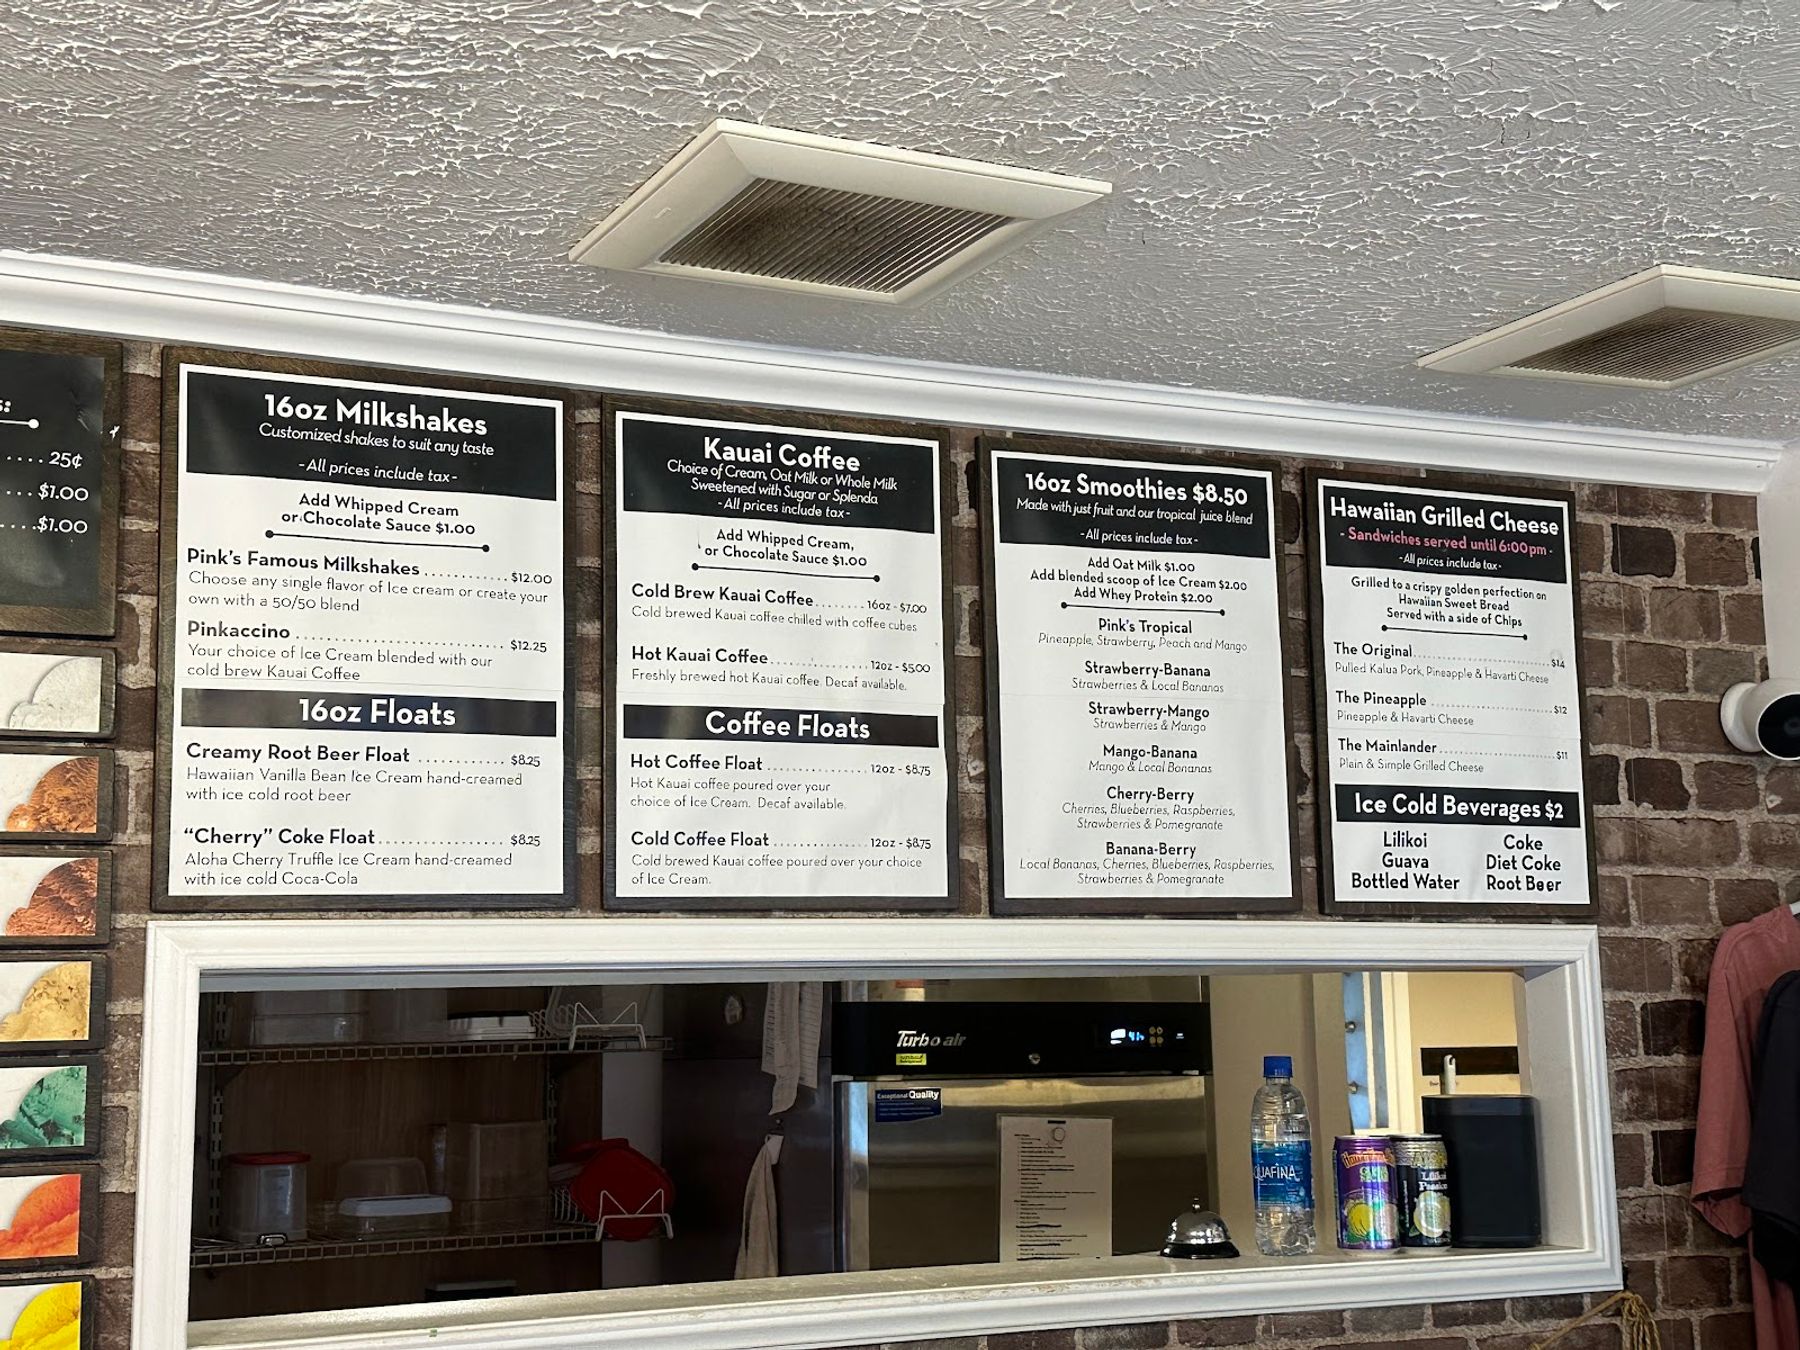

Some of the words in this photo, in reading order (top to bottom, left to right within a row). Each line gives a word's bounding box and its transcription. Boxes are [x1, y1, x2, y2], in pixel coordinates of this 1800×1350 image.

[264, 393, 327, 420] 16oz
[336, 398, 487, 435] Milkshakes
[259, 422, 342, 442] Customized
[343, 429, 388, 447] shakes
[392, 435, 405, 448] to
[408, 437, 431, 450] suit
[434, 442, 459, 455] any
[462, 441, 493, 455] taste
[48, 451, 83, 469] 25¢
[704, 436, 771, 463] Kauai
[778, 443, 860, 471] Coffee
[328, 462, 369, 476] prices
[374, 465, 423, 480] include
[37, 482, 89, 501] $1.00
[1025, 471, 1070, 492] 16oz
[1076, 473, 1187, 500] Smoothies
[1192, 482, 1247, 506] $8.50
[298, 493, 329, 507] Add
[334, 495, 402, 513] Whipped
[408, 501, 458, 516] Cream
[36, 515, 88, 533] $1.00
[281, 512, 298, 523] or
[302, 511, 382, 529] Chocolate
[385, 517, 430, 532] Sauce
[435, 521, 476, 535] $1.00
[1330, 496, 1416, 523] Hawaiian
[1421, 505, 1485, 529] Grilled
[1489, 510, 1558, 535] Cheese
[716, 528, 742, 541] Add
[746, 530, 803, 547] Whipped
[807, 535, 853, 551] Cream,
[1348, 526, 1421, 545] Sandwiches
[1423, 535, 1466, 548] served
[1470, 538, 1496, 551] until
[1498, 539, 1546, 557] 6:00pm
[704, 547, 718, 555] or
[722, 544, 788, 561] Chocolate
[791, 550, 828, 564] Sauce
[832, 554, 866, 566] $1.00
[1087, 556, 1109, 568] Add
[1112, 557, 1133, 570] Oat
[1137, 559, 1161, 571] Milk
[1164, 562, 1195, 572] $1.00
[247, 550, 318, 569] Famous
[324, 555, 419, 575] Milkshakes
[511, 572, 552, 584] $12.00
[1030, 568, 1055, 580] Add
[1058, 569, 1103, 583] blended
[1106, 576, 1139, 586] scoop
[1142, 574, 1154, 586] of
[1158, 574, 1175, 586] Ice
[1178, 575, 1216, 588] Cream
[1218, 579, 1247, 590] $2.00
[631, 582, 669, 597] Cold
[674, 584, 714, 599] Brew
[719, 586, 760, 602] Kauai
[764, 589, 813, 606] Coffee
[867, 599, 890, 610] 16oz
[1074, 585, 1096, 598] Add
[1098, 587, 1131, 602] Whey
[1134, 589, 1177, 601] Protein
[1180, 592, 1212, 603] $2.00
[1398, 593, 1442, 607] Hawaiian
[1444, 597, 1477, 609] Sweet
[1479, 598, 1509, 611] Bread
[187, 620, 289, 638] Pinkaccino
[510, 639, 546, 652] $12.25
[1138, 619, 1192, 635] Tropical
[632, 645, 661, 660] Hot
[666, 646, 710, 661] Kauai
[715, 648, 768, 663] Coffee
[870, 660, 892, 670] 12oz
[1333, 641, 1357, 654] The
[1361, 643, 1412, 659] Original
[1551, 658, 1565, 668] $14
[187, 662, 218, 676] cold
[224, 662, 261, 676] brew
[267, 664, 306, 678] Kauai
[311, 665, 360, 680] Coffee
[1085, 660, 1210, 678] Strawberry-Banana
[299, 698, 361, 722] 16oz
[370, 697, 455, 725] Floats
[1088, 700, 1209, 720] Strawberry-Mango
[1335, 690, 1359, 703] The
[1363, 691, 1426, 708] Pineapple
[1553, 705, 1567, 714] $12
[705, 710, 790, 735] Coffee
[797, 713, 869, 738] Floats
[186, 742, 261, 762] Creamy
[268, 743, 311, 760] Root
[317, 744, 359, 760] Beer
[365, 745, 409, 762] Float
[510, 754, 540, 767] $8.25
[1103, 744, 1197, 760] Mango-Banana
[1337, 737, 1361, 751] The
[1365, 738, 1436, 752] Mainlander
[1556, 750, 1567, 760] $11
[631, 753, 660, 768] Hot
[665, 753, 720, 769] Coffee
[725, 754, 762, 770] Float
[871, 764, 894, 773] 12oz
[185, 786, 216, 799] with
[222, 791, 243, 799] ice
[248, 787, 279, 800] cold
[284, 788, 313, 801] root
[318, 788, 350, 801] beer
[1106, 785, 1194, 803] Cherry-Berry
[1355, 792, 1386, 813] Ice
[1392, 792, 1436, 814] Cold
[1443, 794, 1540, 821] Beverages
[1544, 799, 1563, 820] $2
[1076, 816, 1140, 829] Strawberries
[1143, 817, 1151, 829] &
[1154, 817, 1222, 832] Pomegranate
[278, 828, 323, 843] Coke
[329, 828, 374, 844] Float
[510, 833, 540, 846] $8.25
[631, 830, 668, 845] Cold
[673, 830, 725, 845] Coffee
[731, 831, 769, 846] Float
[870, 837, 895, 847] 12oz
[1383, 830, 1426, 847] Lilikoi
[1503, 834, 1543, 850] Coke
[1106, 841, 1196, 858] Banana-Berry
[1382, 851, 1428, 868] Guava
[1486, 853, 1517, 870] Diet
[1521, 854, 1561, 870] Coke
[1351, 872, 1408, 888] Bottled
[1412, 873, 1459, 889] Water
[1486, 874, 1521, 890] Root
[1525, 875, 1561, 891] Beer
[896, 1030, 941, 1048] Turbo
[943, 1033, 967, 1047] air
[909, 1090, 940, 1100] Quality
